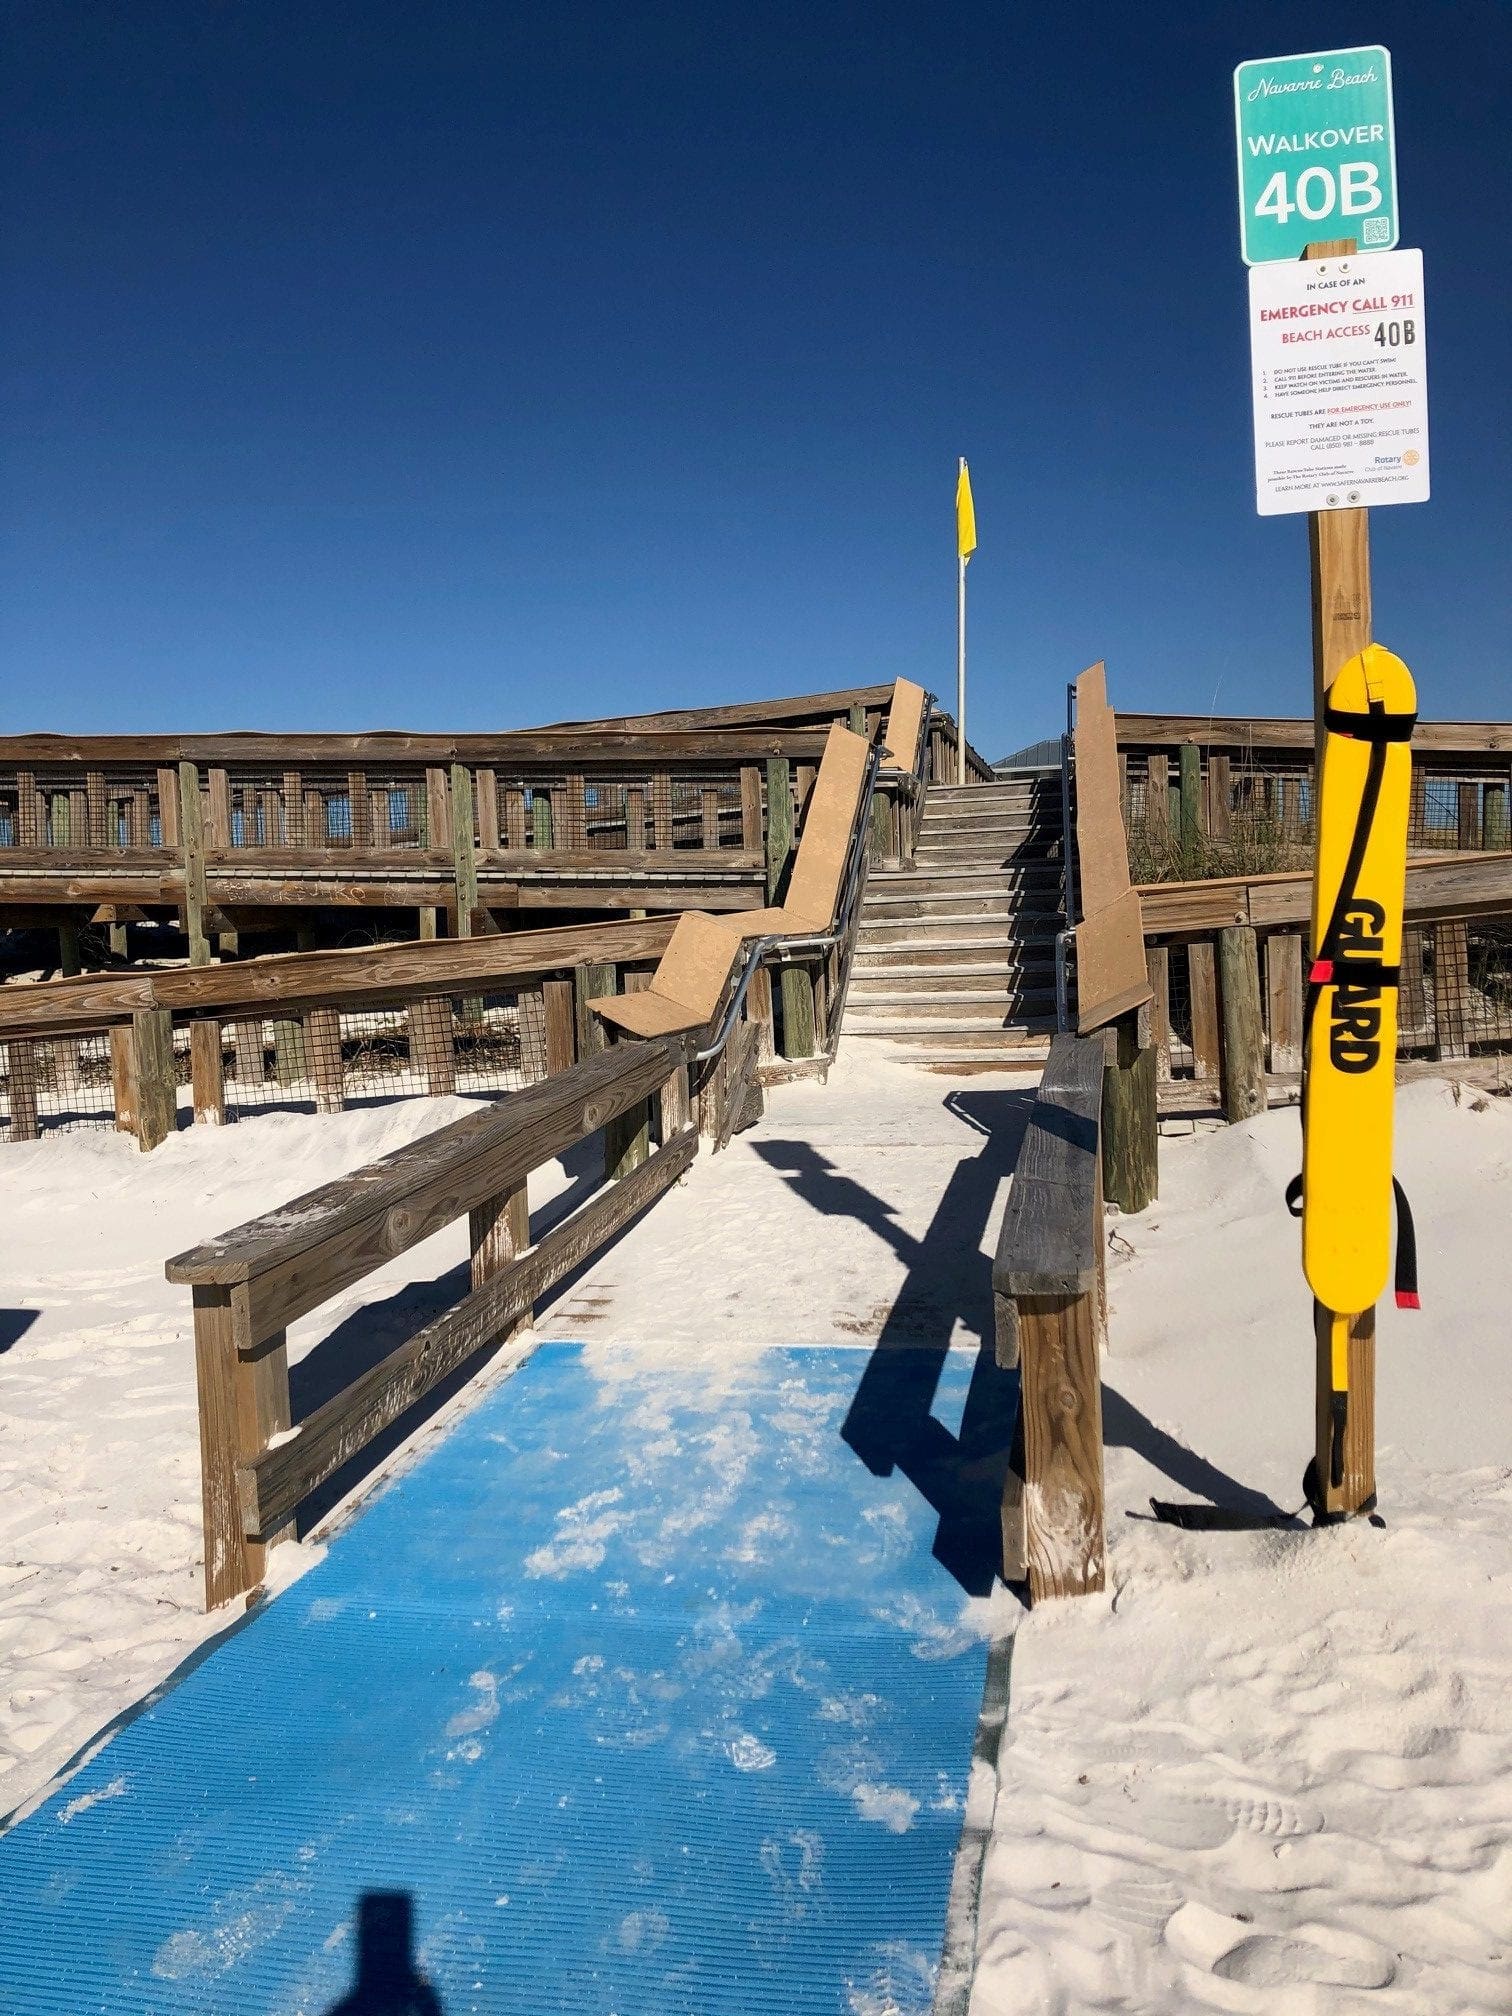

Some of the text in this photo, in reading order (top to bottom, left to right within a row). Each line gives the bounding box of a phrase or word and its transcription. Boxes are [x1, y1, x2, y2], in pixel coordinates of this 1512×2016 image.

[1248, 66, 1377, 101] Navarre Beach
[1248, 125, 1384, 157] WALKOVER
[1255, 162, 1382, 224] 40B
[1318, 281, 1337, 289] CASE
[1261, 294, 1414, 321] EMERGENCY CALL 911
[1282, 320, 1415, 347] BEACH ACCESS 40B
[1341, 404, 1378, 412] EMERGENCY
[1375, 456, 1401, 464] Rotary
[1330, 898, 1386, 1074] GUARD
